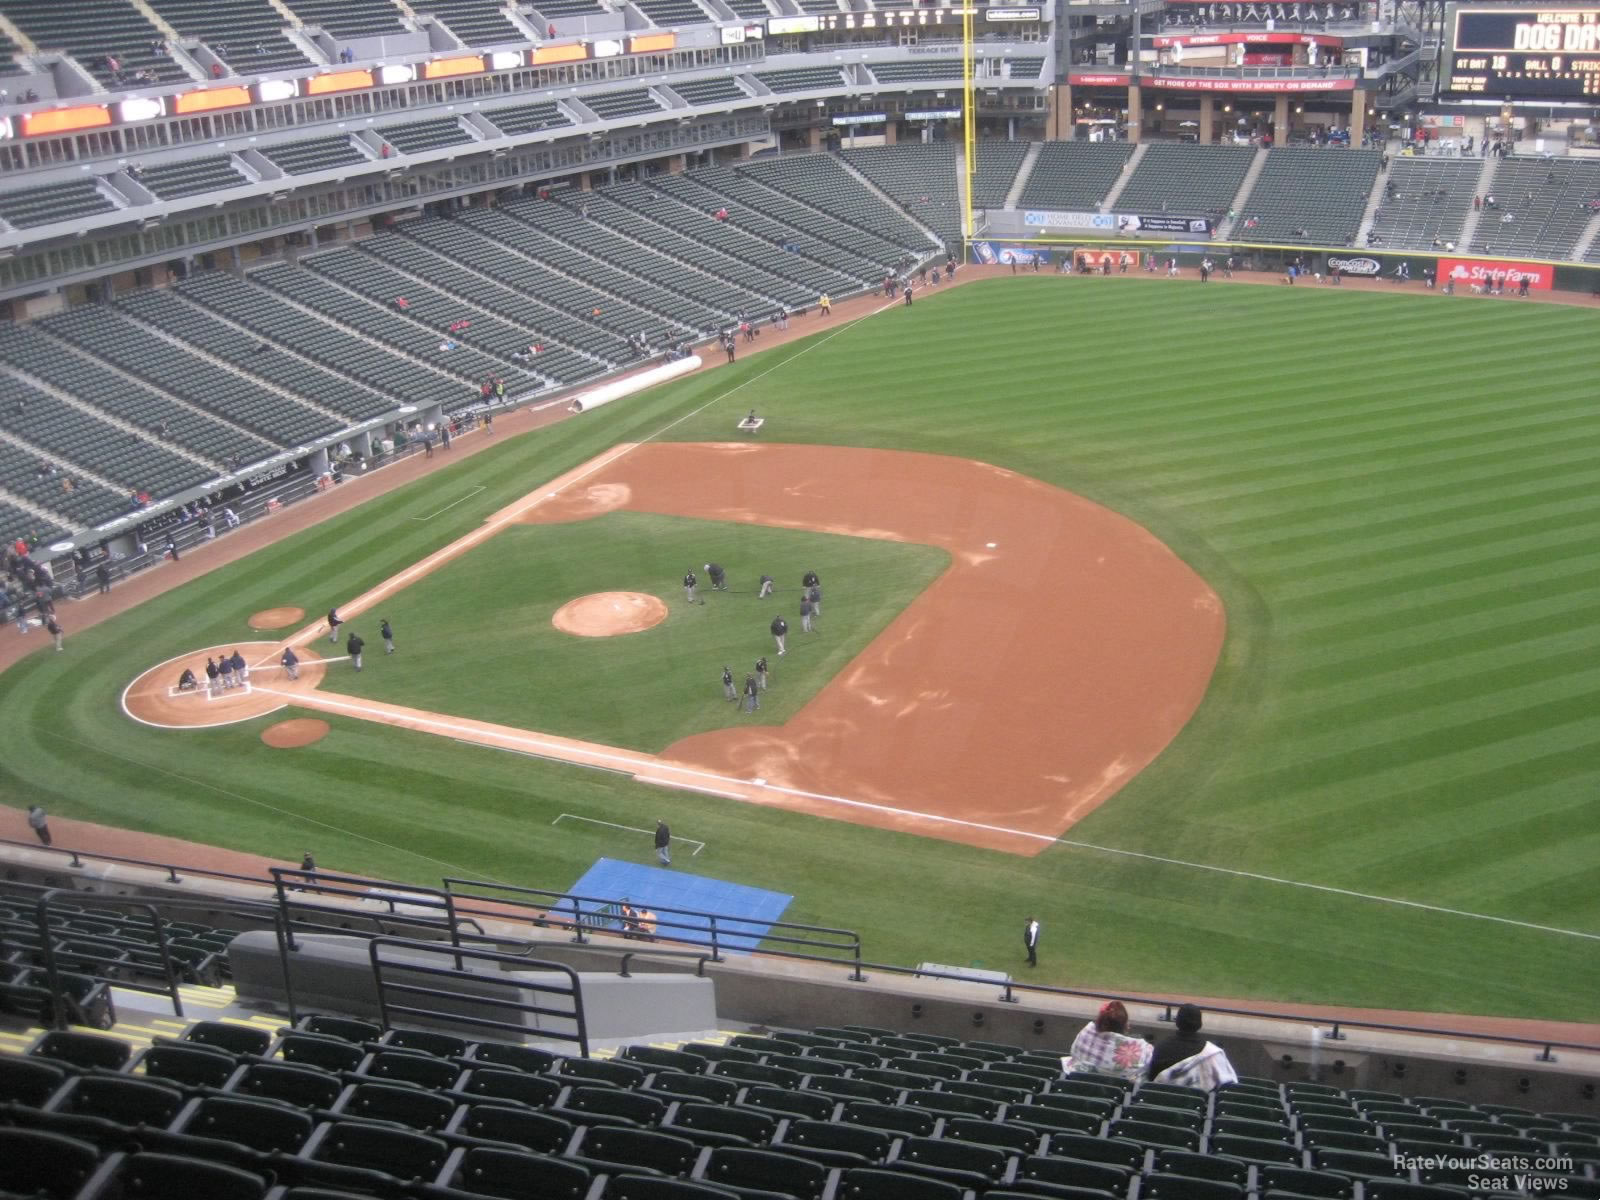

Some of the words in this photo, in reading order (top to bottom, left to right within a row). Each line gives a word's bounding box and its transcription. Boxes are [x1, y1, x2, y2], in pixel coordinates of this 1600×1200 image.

[1190, 35, 1219, 44] INTERNET
[1246, 34, 1268, 42] VOICE
[1514, 23, 1561, 50] DOG
[1457, 59, 1469, 69] AT
[1470, 59, 1487, 69] BAT
[1525, 60, 1548, 71] BALL
[1187, 80, 1196, 88] OF
[1470, 266, 1505, 280] State
[1505, 268, 1540, 283] Farm
